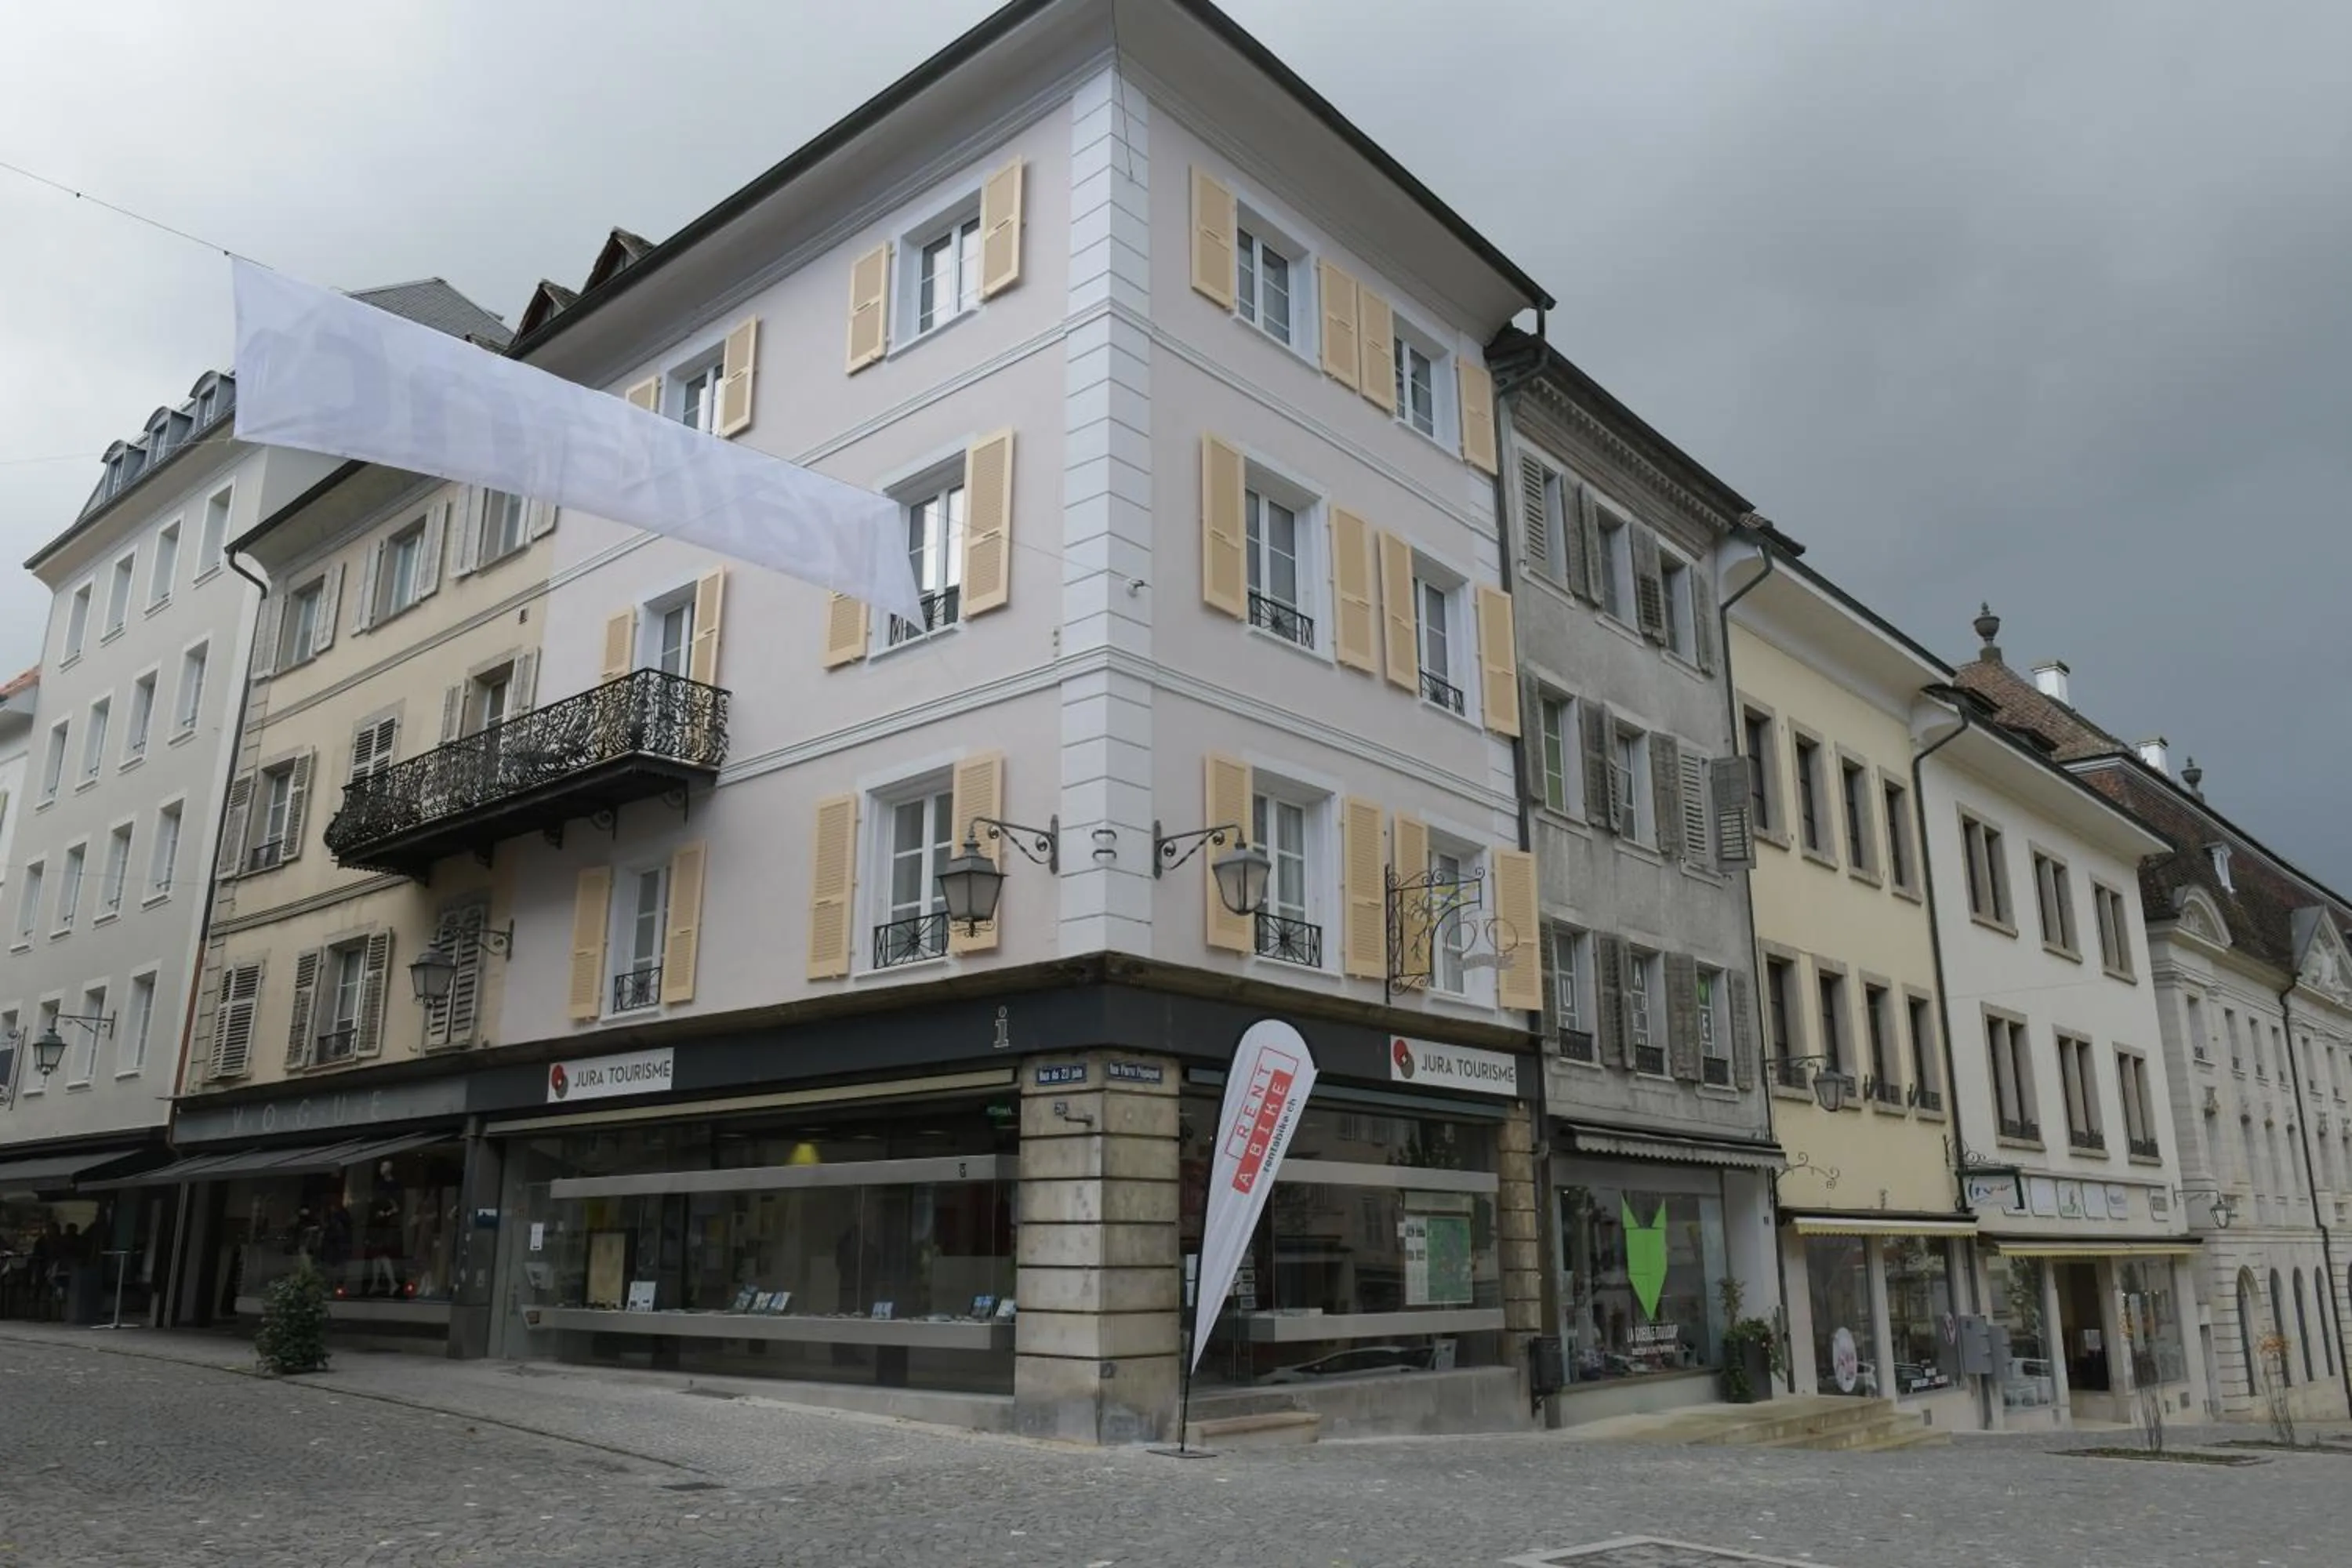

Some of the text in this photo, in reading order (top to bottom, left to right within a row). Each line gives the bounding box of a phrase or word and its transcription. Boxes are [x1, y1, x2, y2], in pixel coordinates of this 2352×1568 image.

[575, 1060, 670, 1087] JURA TOURISME
[1421, 1054, 1515, 1083] JURA TOURISME
[1237, 1065, 1271, 1138] RENT
[1239, 1081, 1287, 1186] A BIKE
